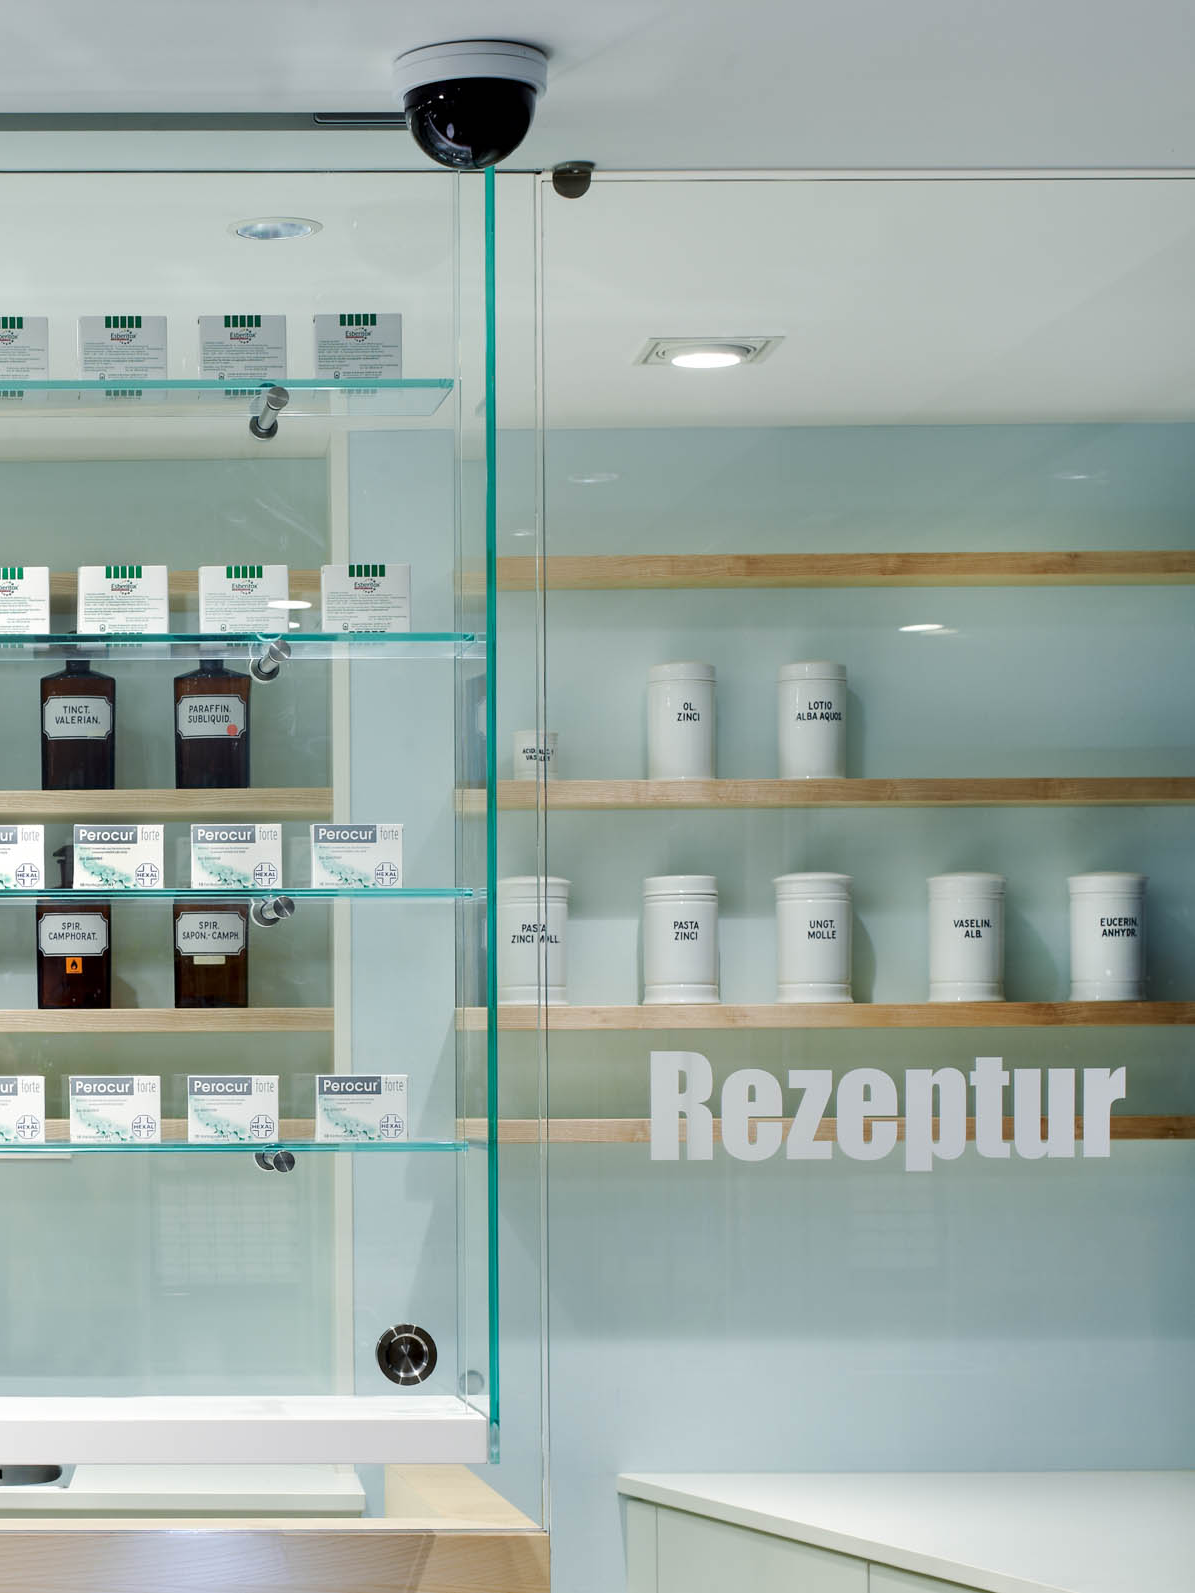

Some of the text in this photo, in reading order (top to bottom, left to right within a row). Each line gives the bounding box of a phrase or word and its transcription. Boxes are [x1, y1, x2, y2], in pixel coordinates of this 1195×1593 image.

[63, 706, 91, 714] TINCT.
[188, 705, 232, 713] PARAFFIN.
[808, 701, 832, 710] LOTIO
[55, 716, 101, 725] VALERIAN.
[677, 712, 700, 721] ZINCI
[796, 712, 817, 720] ALBA
[21, 829, 39, 841] forte
[79, 828, 159, 841] Perocur forte
[198, 827, 278, 840] Perocur forte
[319, 827, 399, 840] Perocur forte
[61, 922, 83, 930] SPIR.
[198, 921, 220, 930] SPIR.
[673, 921, 699, 930] PASTA
[809, 920, 836, 929] UNGT.
[953, 919, 992, 929] VASELIN.
[48, 932, 98, 940] CAMPHORAT.
[511, 935, 534, 944] ZINCI
[674, 932, 698, 941] ZINCI
[807, 930, 836, 940] MOLLE
[21, 1080, 40, 1093] forte
[76, 1080, 156, 1093] Perocur forte
[194, 1079, 274, 1092] Perocur forte
[324, 1078, 404, 1091] Perocur forte
[650, 1050, 1126, 1172] Rezeptur
